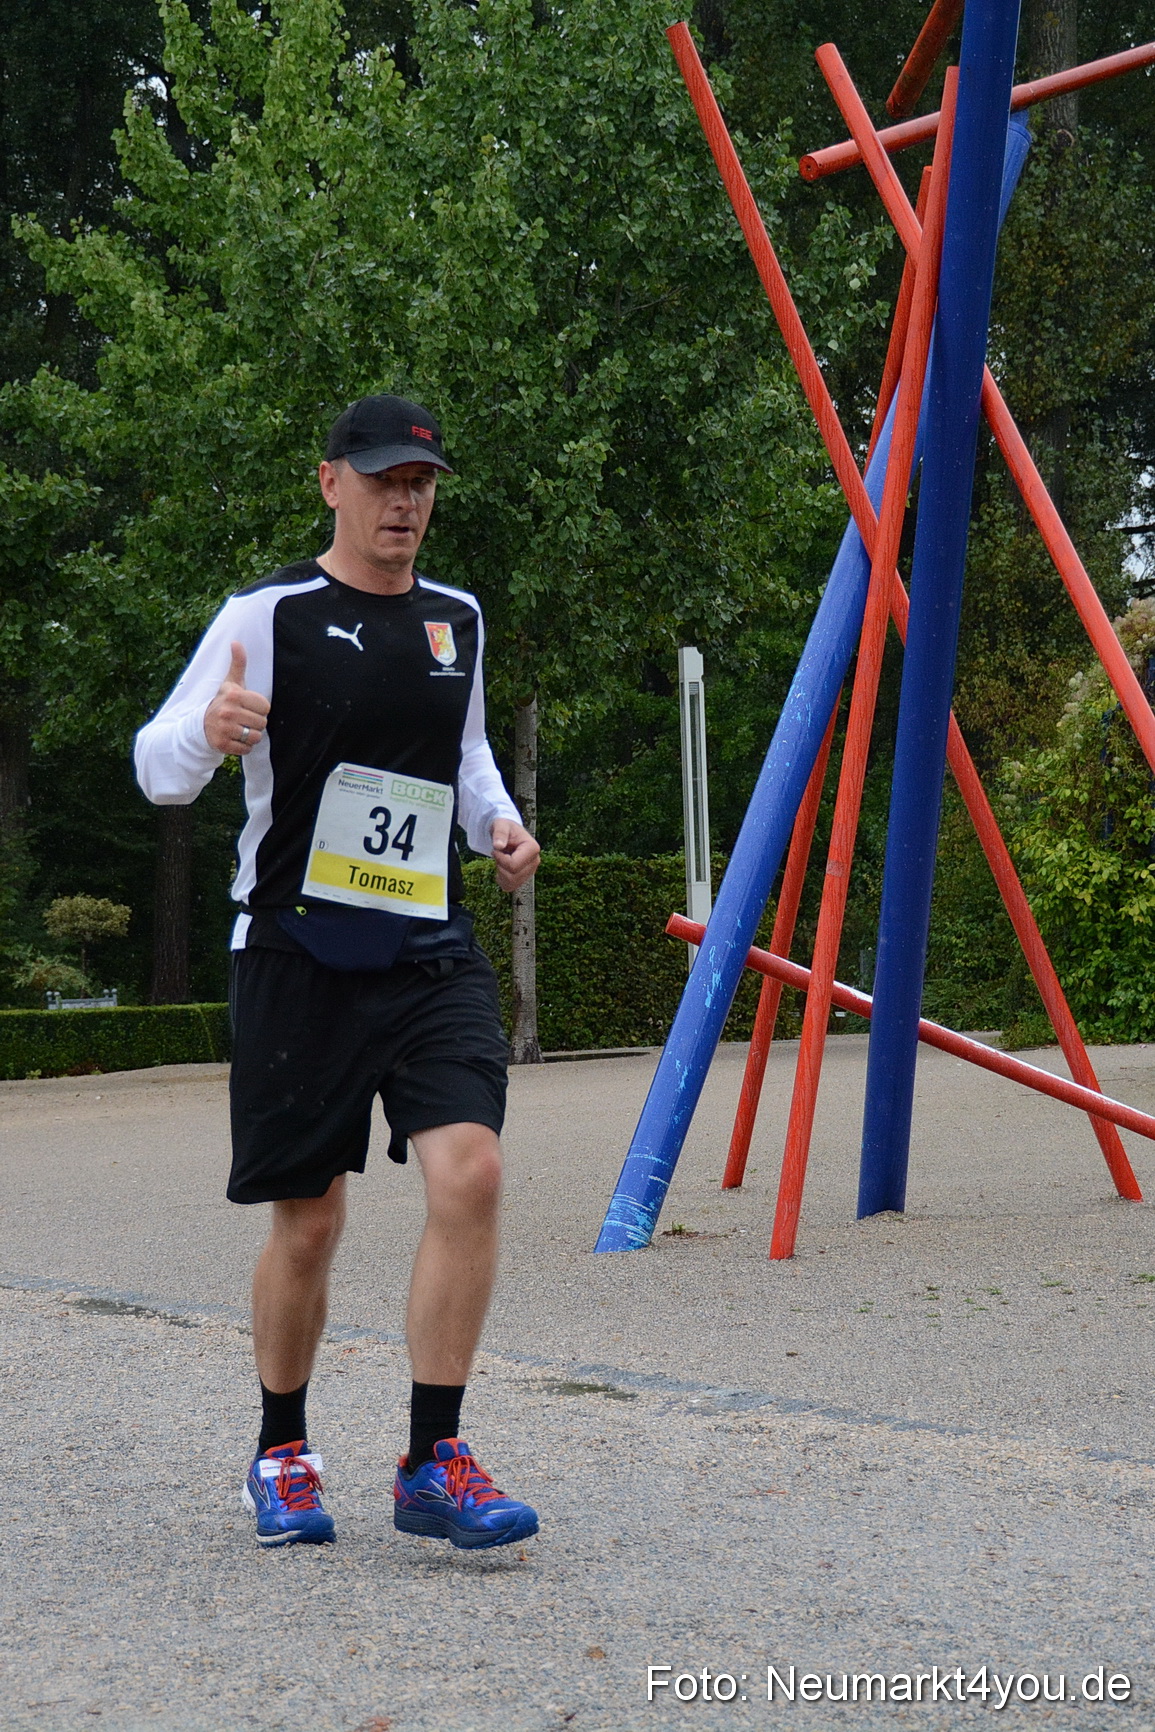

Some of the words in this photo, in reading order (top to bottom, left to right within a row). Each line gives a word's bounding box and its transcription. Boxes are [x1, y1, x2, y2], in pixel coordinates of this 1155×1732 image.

[338, 778, 384, 795] NeuerMarkt
[390, 779, 448, 807] BOCK
[363, 806, 418, 862] 34
[348, 865, 415, 896] Tomasz
